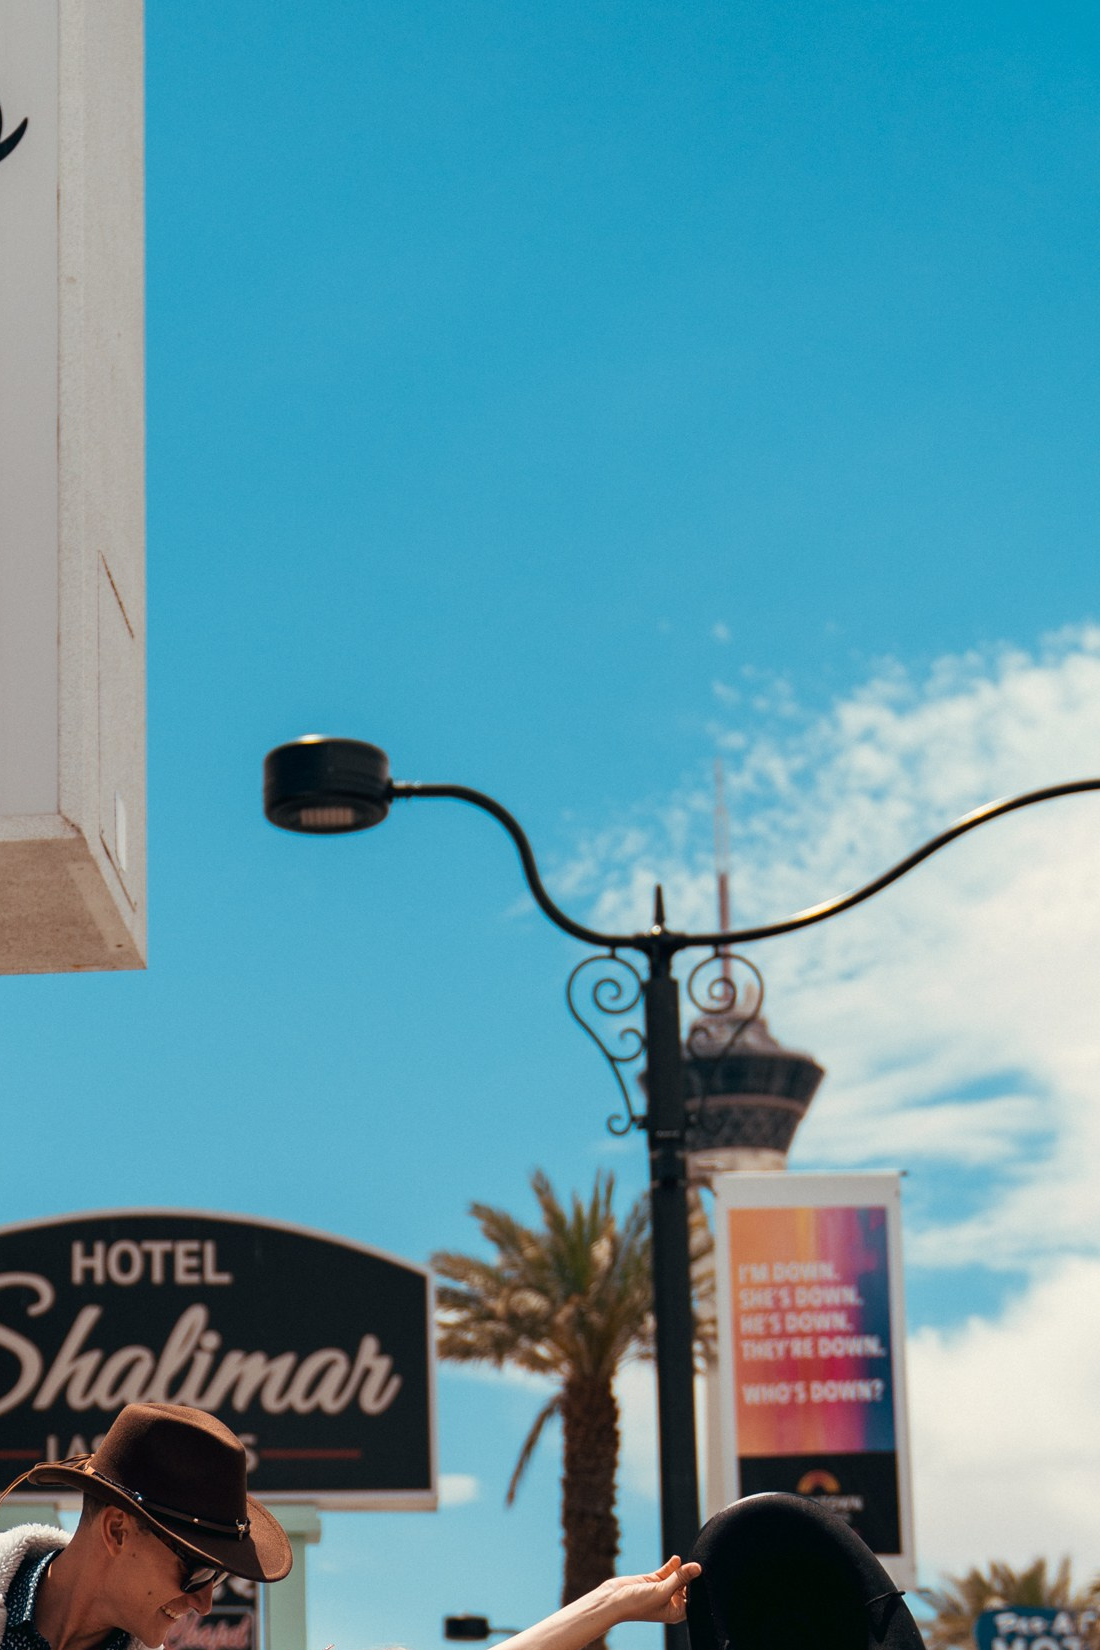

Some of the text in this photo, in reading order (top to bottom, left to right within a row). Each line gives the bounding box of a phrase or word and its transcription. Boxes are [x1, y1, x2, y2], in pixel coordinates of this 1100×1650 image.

[70, 1240, 233, 1287] HOTEL
[773, 1261, 841, 1282] DOWN.
[739, 1284, 864, 1310] SHE'S DOWN.
[785, 1311, 855, 1333] DOWN.
[741, 1334, 887, 1361] THEY'RE DOWN.
[743, 1378, 885, 1405] WHO'S DOWN?
